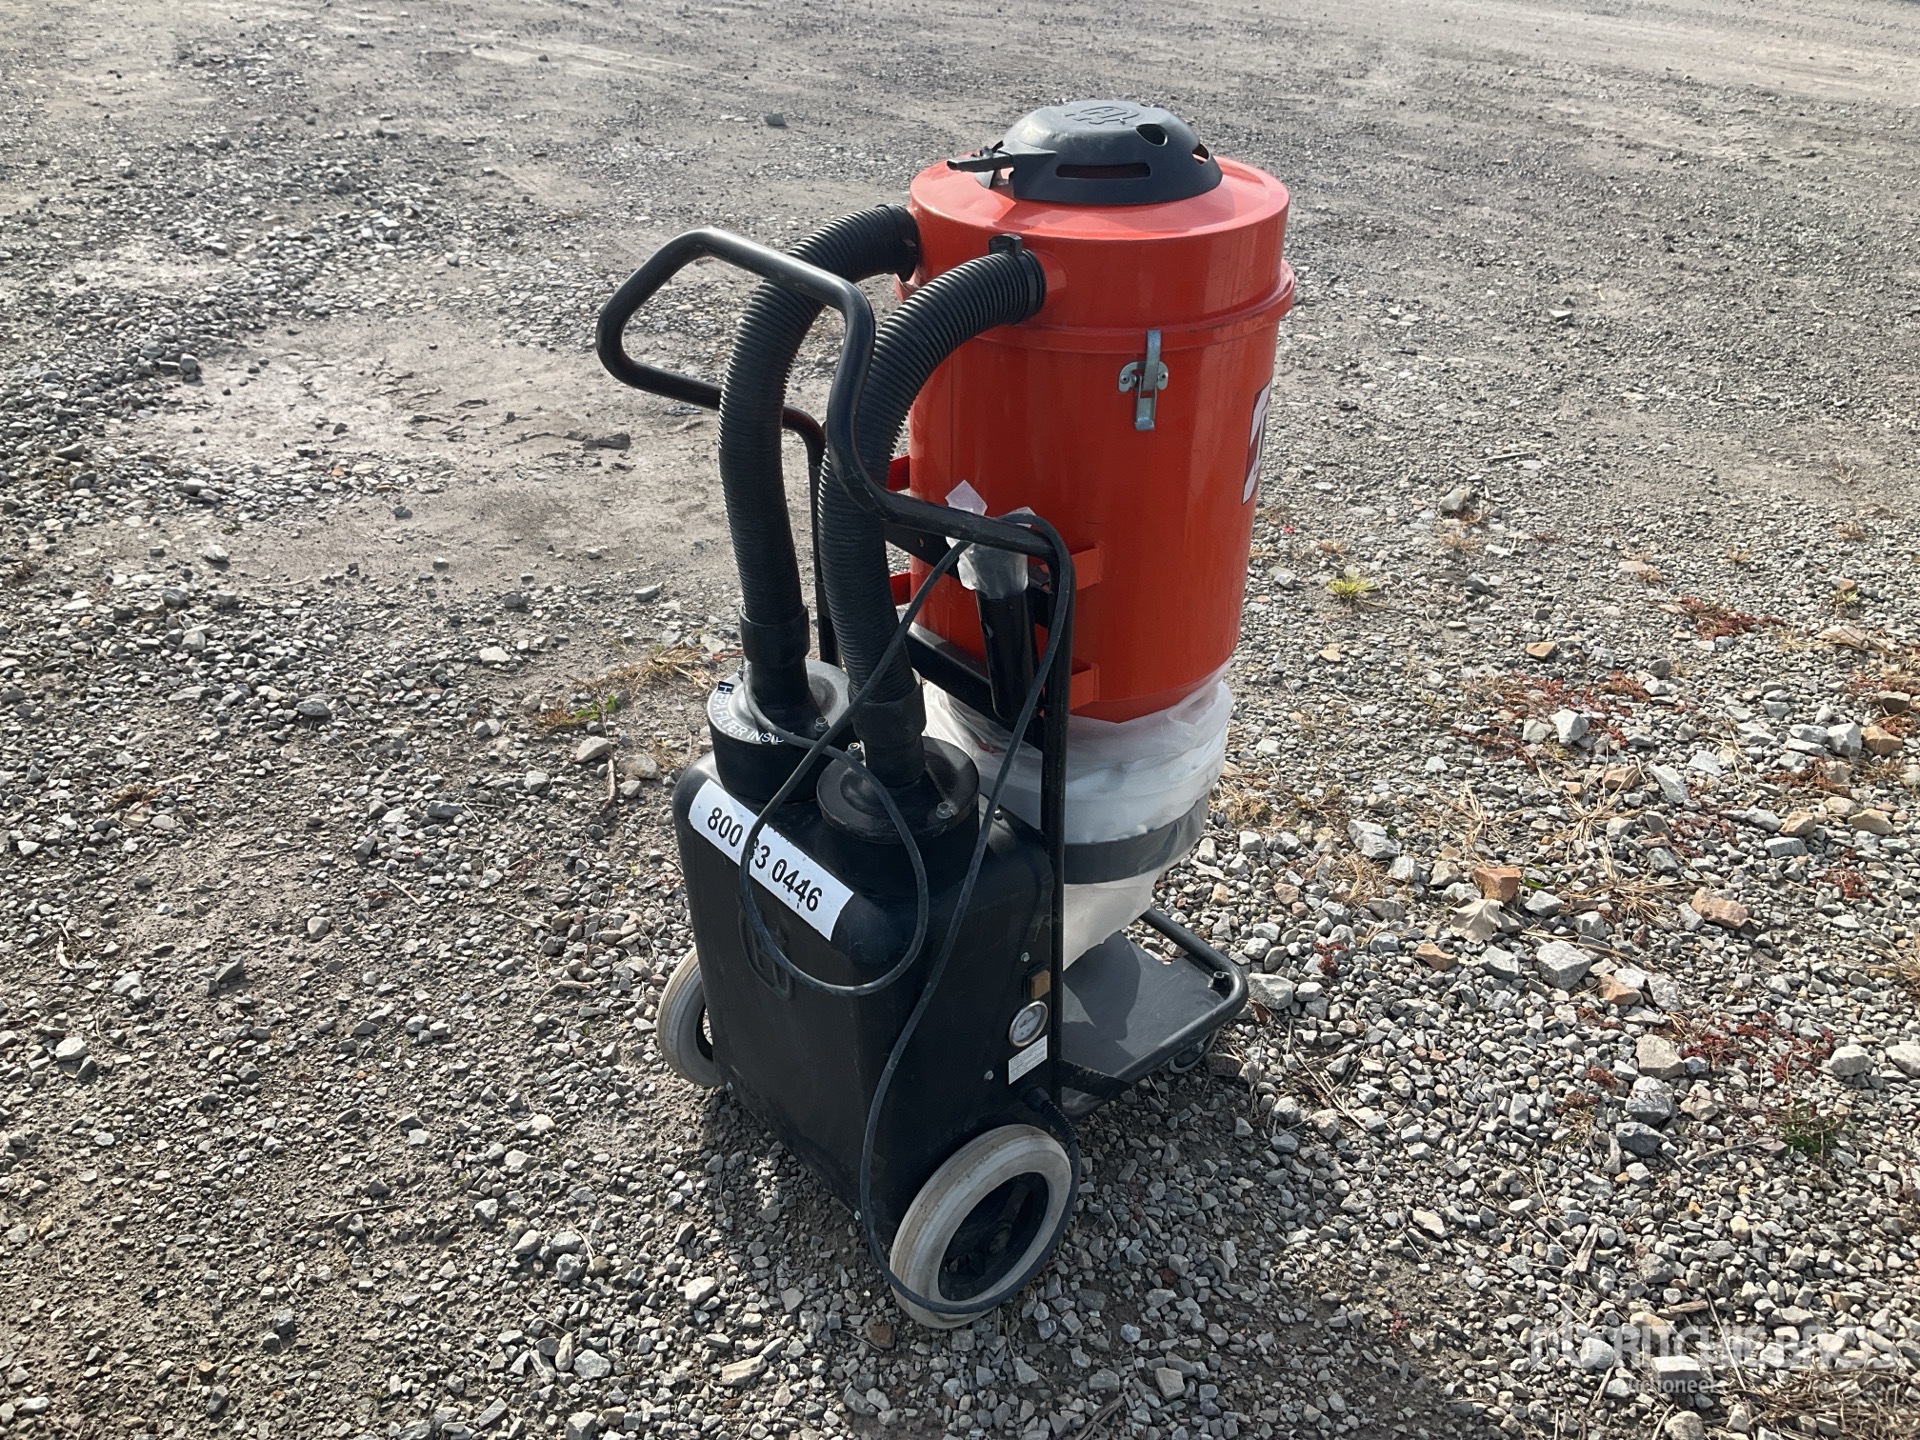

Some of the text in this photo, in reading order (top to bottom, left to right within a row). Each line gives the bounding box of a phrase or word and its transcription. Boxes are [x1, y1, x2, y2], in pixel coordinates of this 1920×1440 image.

[712, 684, 734, 711] HEPA
[713, 708, 748, 737] FILTER
[707, 807, 743, 847] 800
[772, 858, 822, 912] 0446
